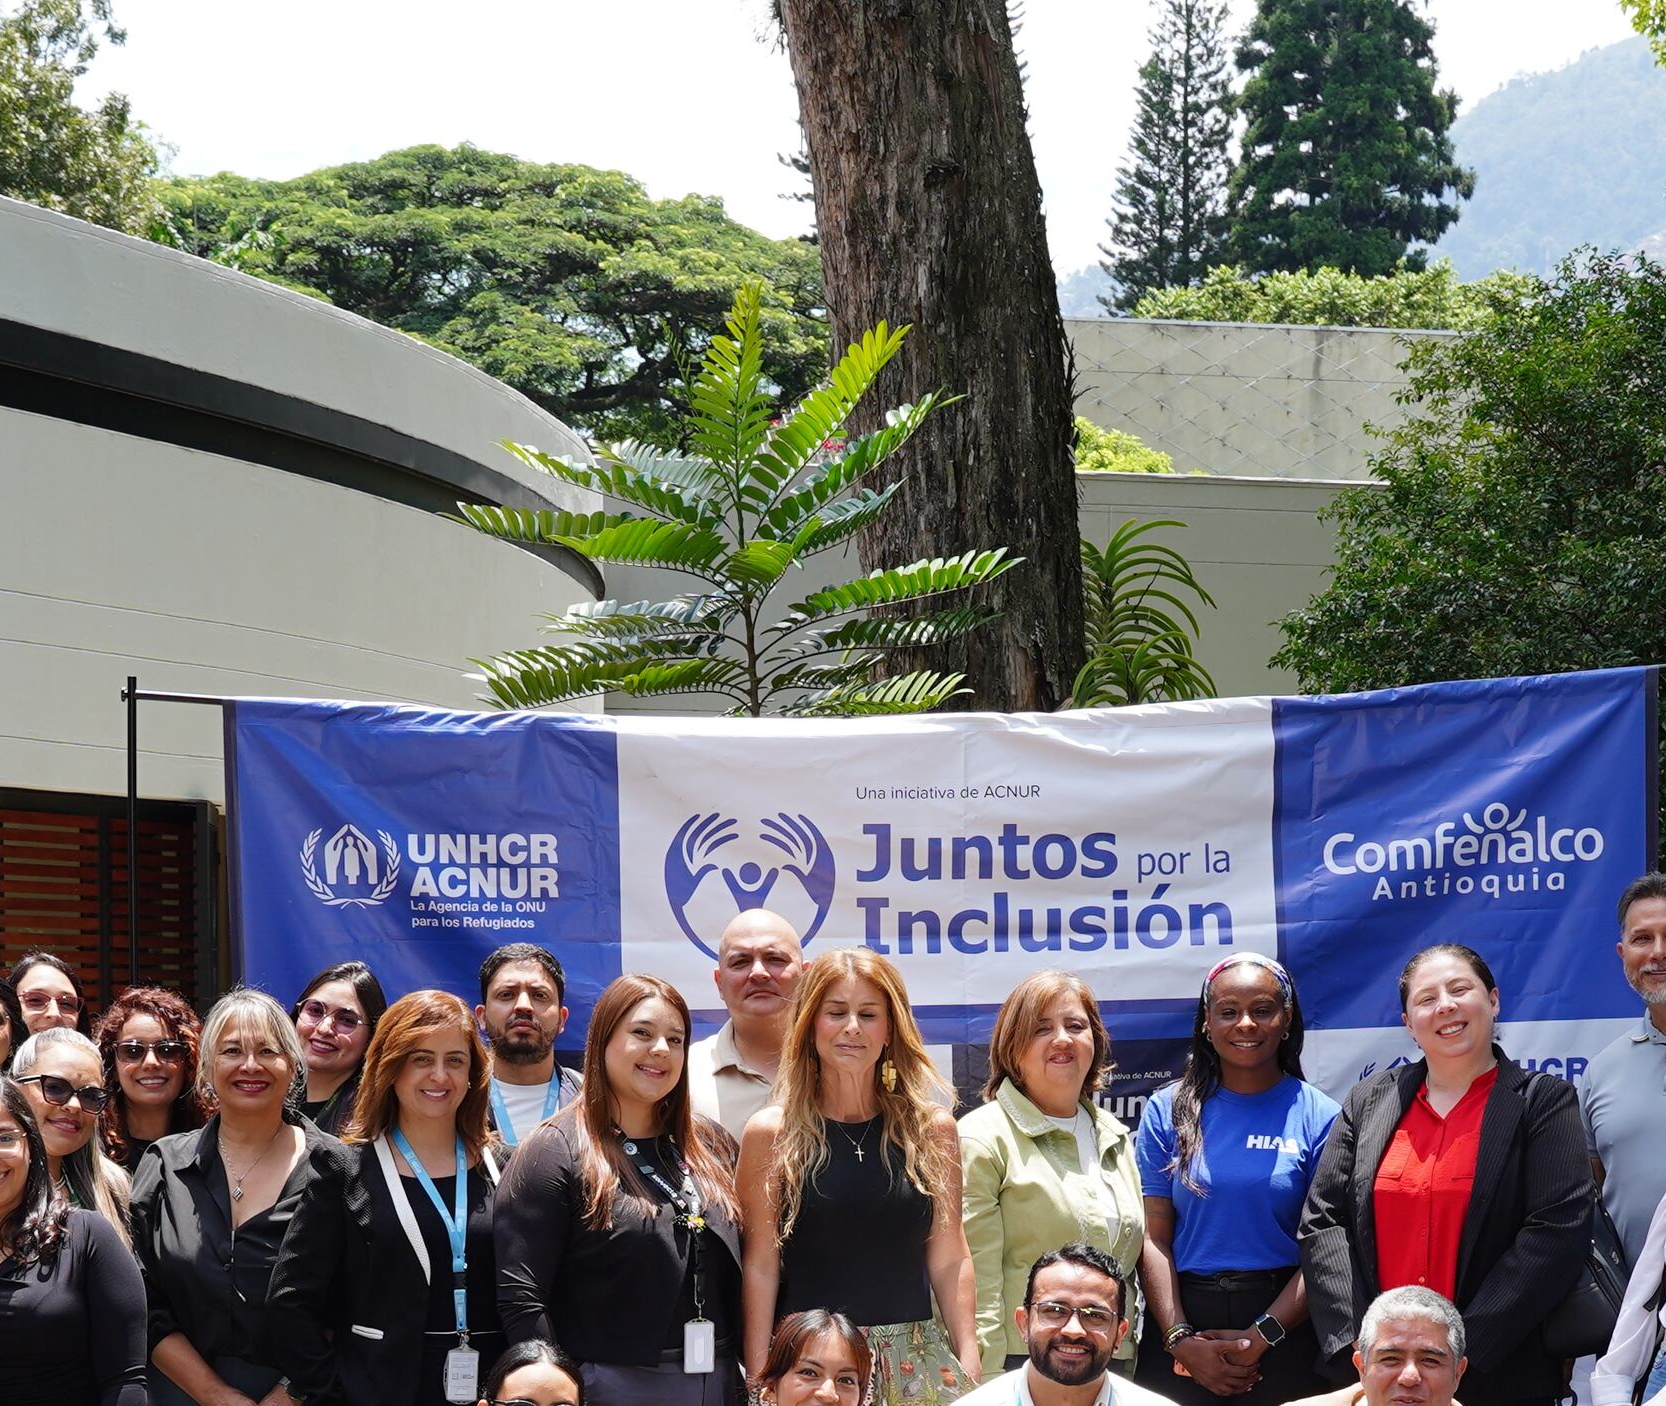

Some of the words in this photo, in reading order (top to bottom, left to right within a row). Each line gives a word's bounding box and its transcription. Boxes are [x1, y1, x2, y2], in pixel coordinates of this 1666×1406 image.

[855, 786, 886, 800] Una
[891, 785, 955, 800] iniciativa
[960, 786, 979, 800] de
[984, 784, 1041, 799] ACNUR
[407, 833, 559, 865] UNHCR
[855, 823, 1118, 882] Juntos
[1137, 850, 1191, 883] por
[1204, 843, 1231, 874] la
[1323, 802, 1605, 875] Comfenalco
[409, 866, 560, 899] ACNUR
[1371, 867, 1566, 901] Antioquia
[410, 900, 425, 911] La
[428, 900, 479, 913] Agencia
[482, 901, 499, 912] de
[501, 901, 513, 912] la
[515, 901, 546, 913] ONU
[856, 884, 1234, 956] Inclusión
[411, 917, 439, 928] para
[441, 917, 460, 928] los
[462, 916, 535, 930] Refugiados
[1143, 1070, 1172, 1079] ACNUR
